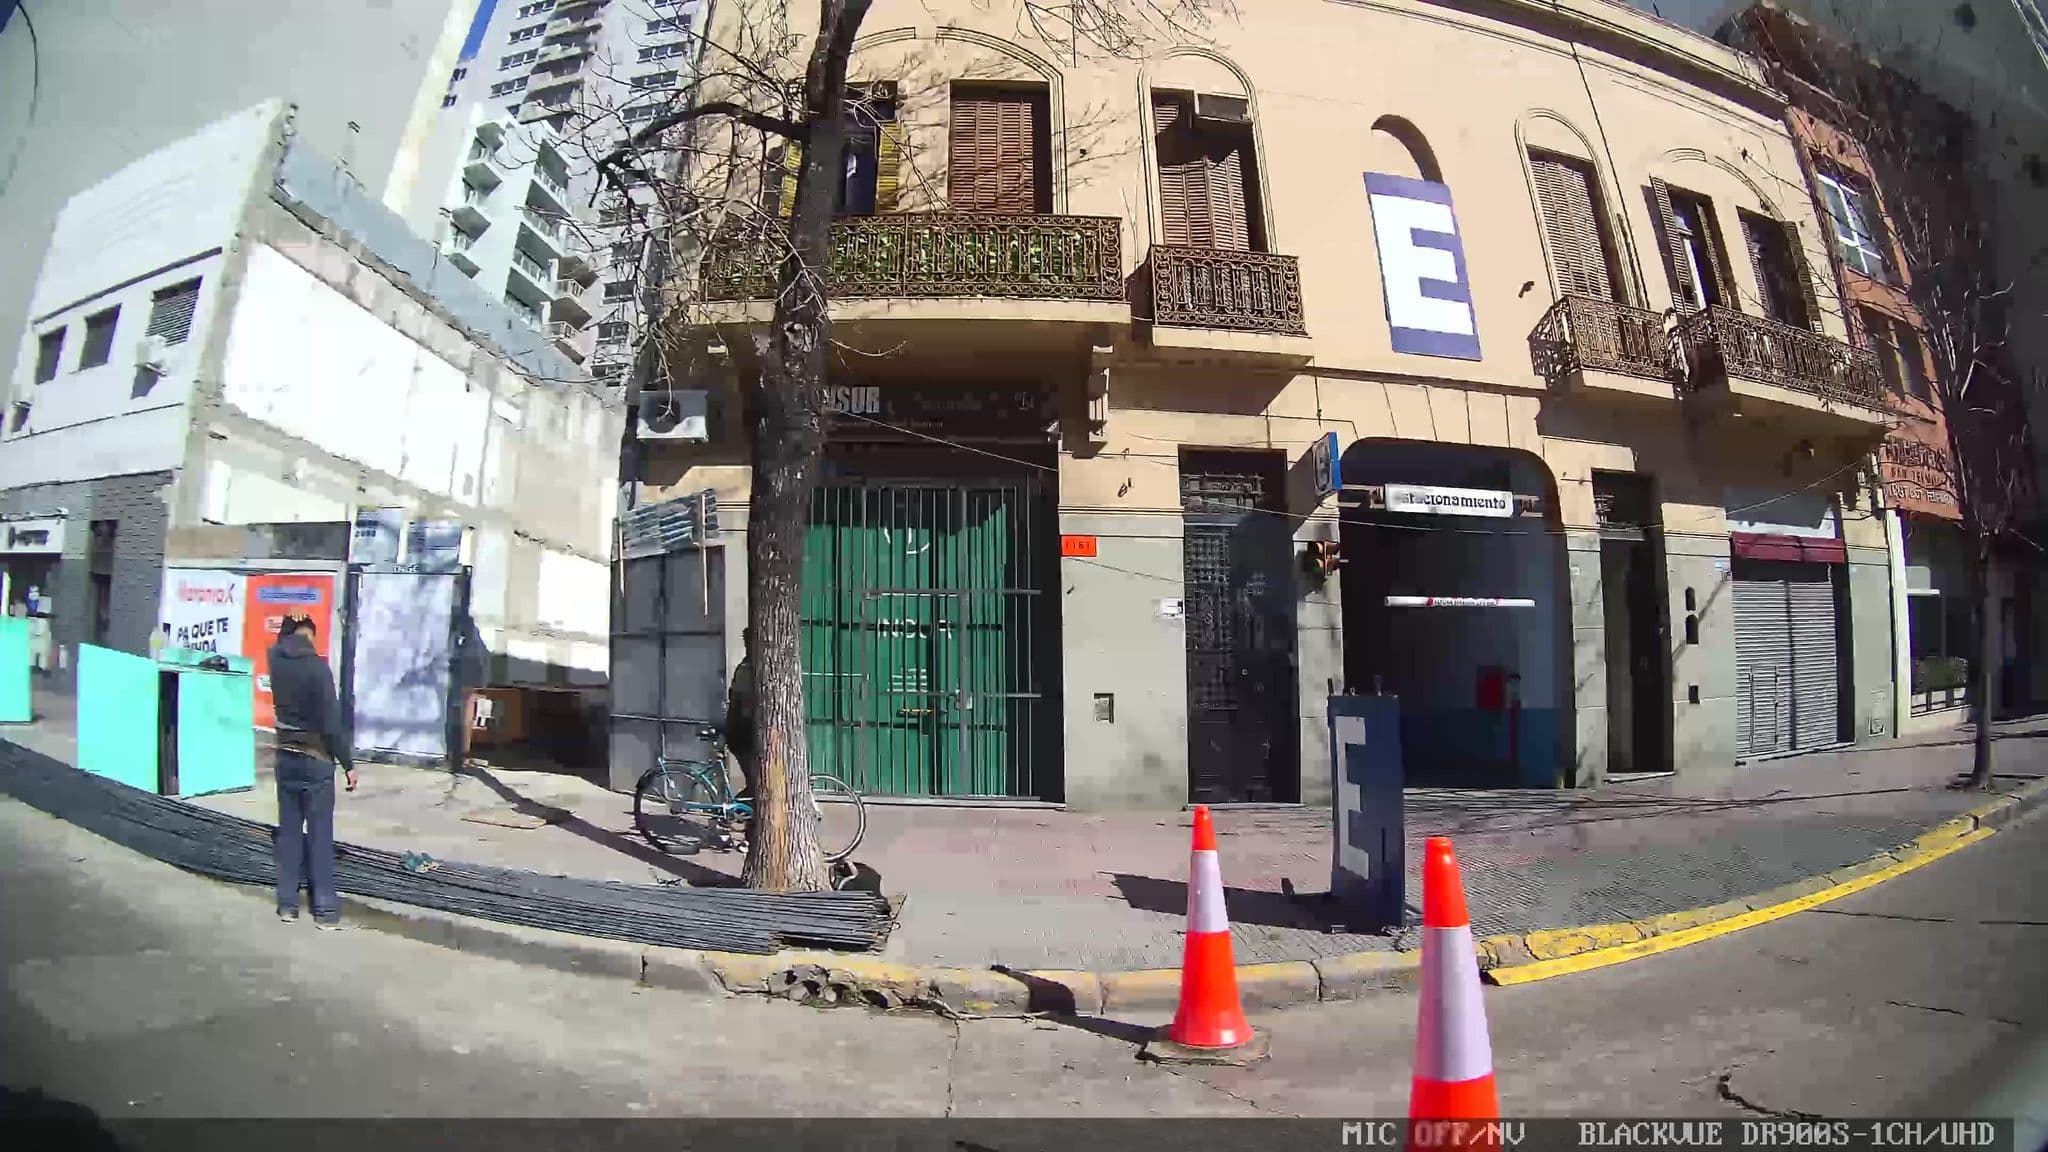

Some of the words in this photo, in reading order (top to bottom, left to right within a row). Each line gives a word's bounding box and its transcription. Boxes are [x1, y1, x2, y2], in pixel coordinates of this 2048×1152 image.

[1369, 193, 1475, 336] E
[191, 620, 214, 638] QUE
[216, 616, 229, 633] TE
[1335, 715, 1370, 881] E
